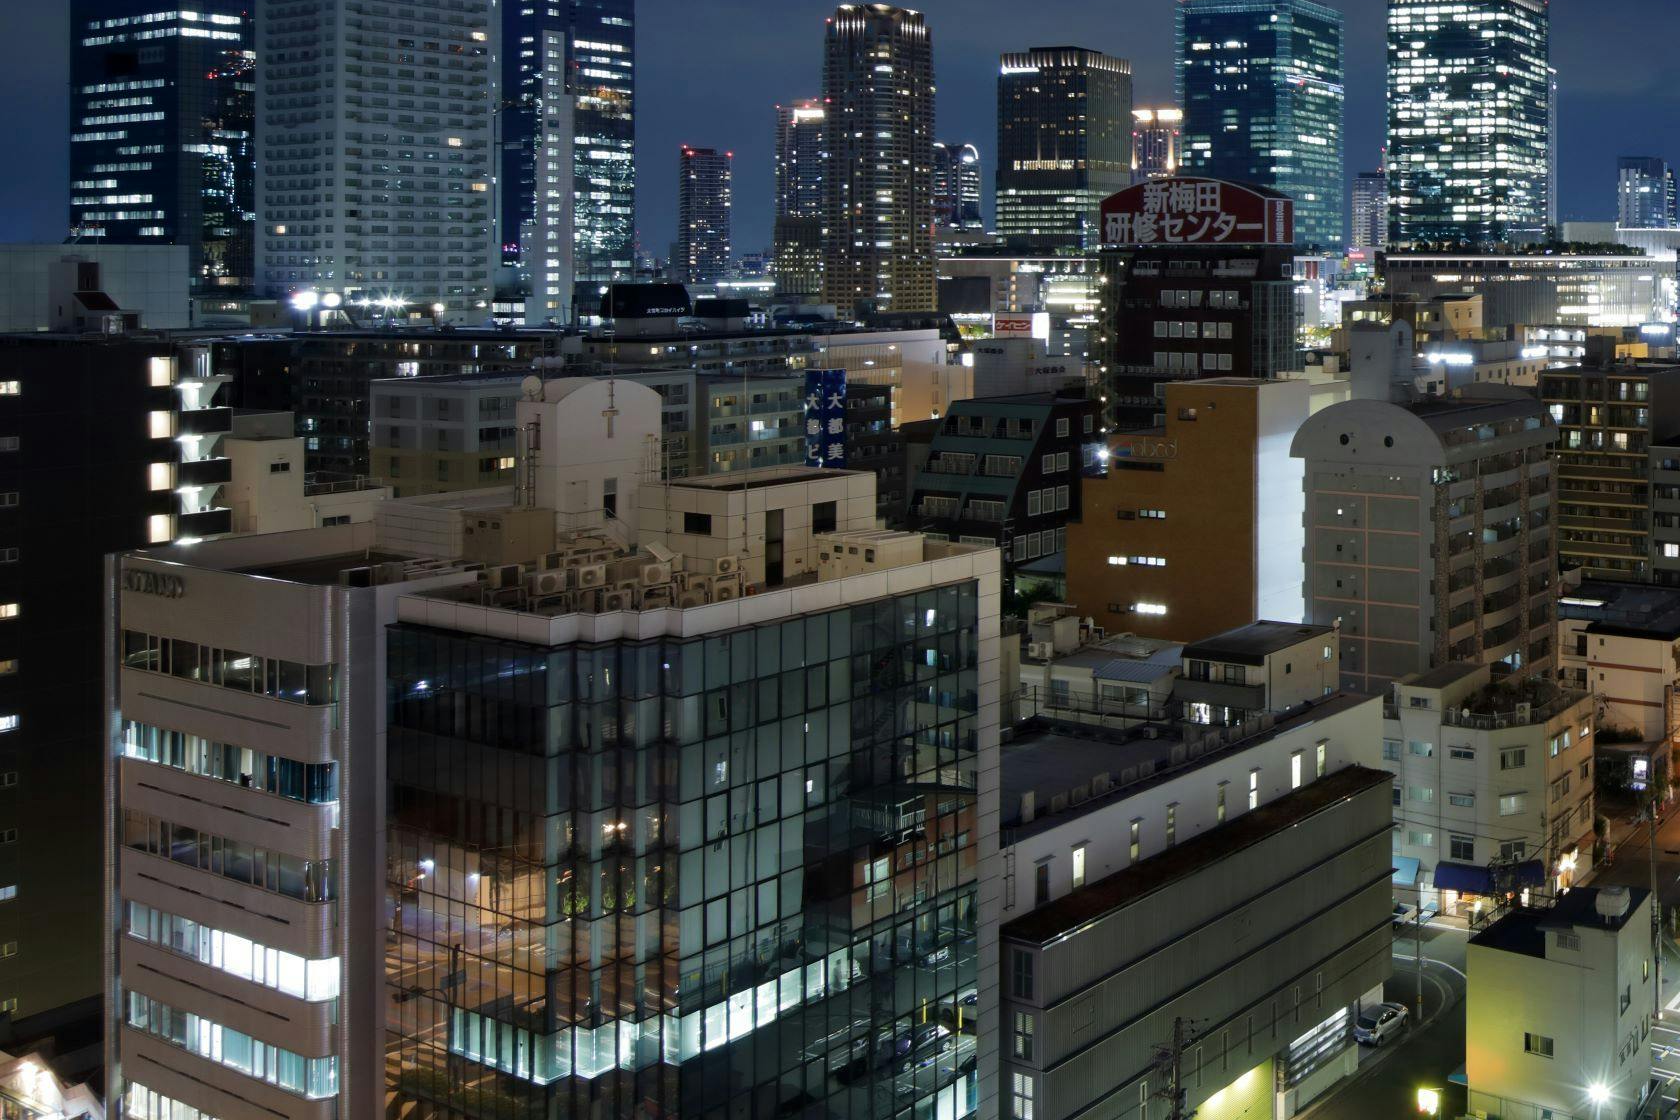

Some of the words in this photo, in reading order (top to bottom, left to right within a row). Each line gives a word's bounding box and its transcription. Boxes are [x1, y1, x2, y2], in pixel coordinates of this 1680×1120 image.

[1143, 182, 1221, 214] 新梅田
[1105, 212, 1263, 243] 研修センター
